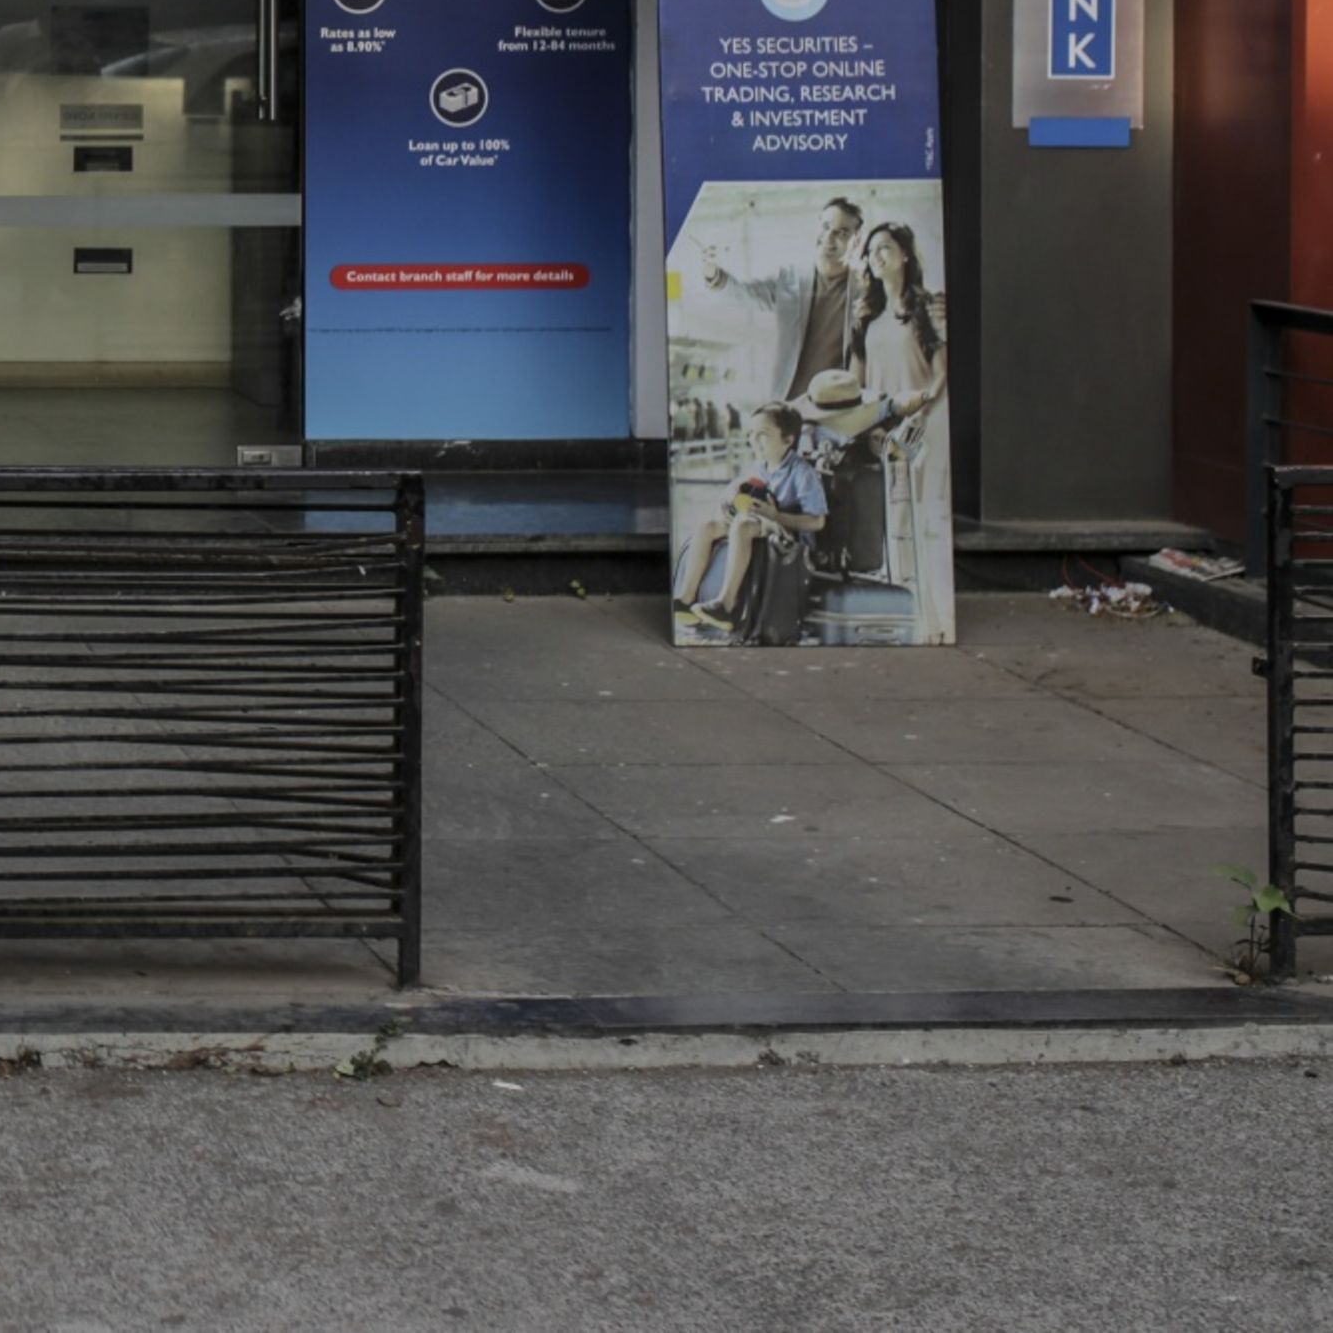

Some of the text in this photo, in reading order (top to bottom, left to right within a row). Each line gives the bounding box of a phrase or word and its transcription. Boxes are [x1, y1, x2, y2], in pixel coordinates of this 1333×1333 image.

[320, 27, 396, 39] Rates as low
[514, 26, 606, 38] Flexible tenure
[330, 42, 343, 52] as
[498, 40, 528, 52] from
[568, 40, 615, 51] months
[720, 36, 858, 54] YES SECURITIES
[710, 60, 886, 79] ONE-STOP ONLINE
[702, 84, 896, 104] TRADING, RESEARCH
[731, 109, 868, 127] & INVESTMENT
[409, 140, 439, 151] Loan
[442, 142, 458, 154] up
[462, 140, 475, 151] to
[753, 134, 848, 151] ADVISORY
[420, 154, 434, 166] of
[436, 155, 458, 166] Car
[347, 269, 574, 282] Contact branch staff for more details
